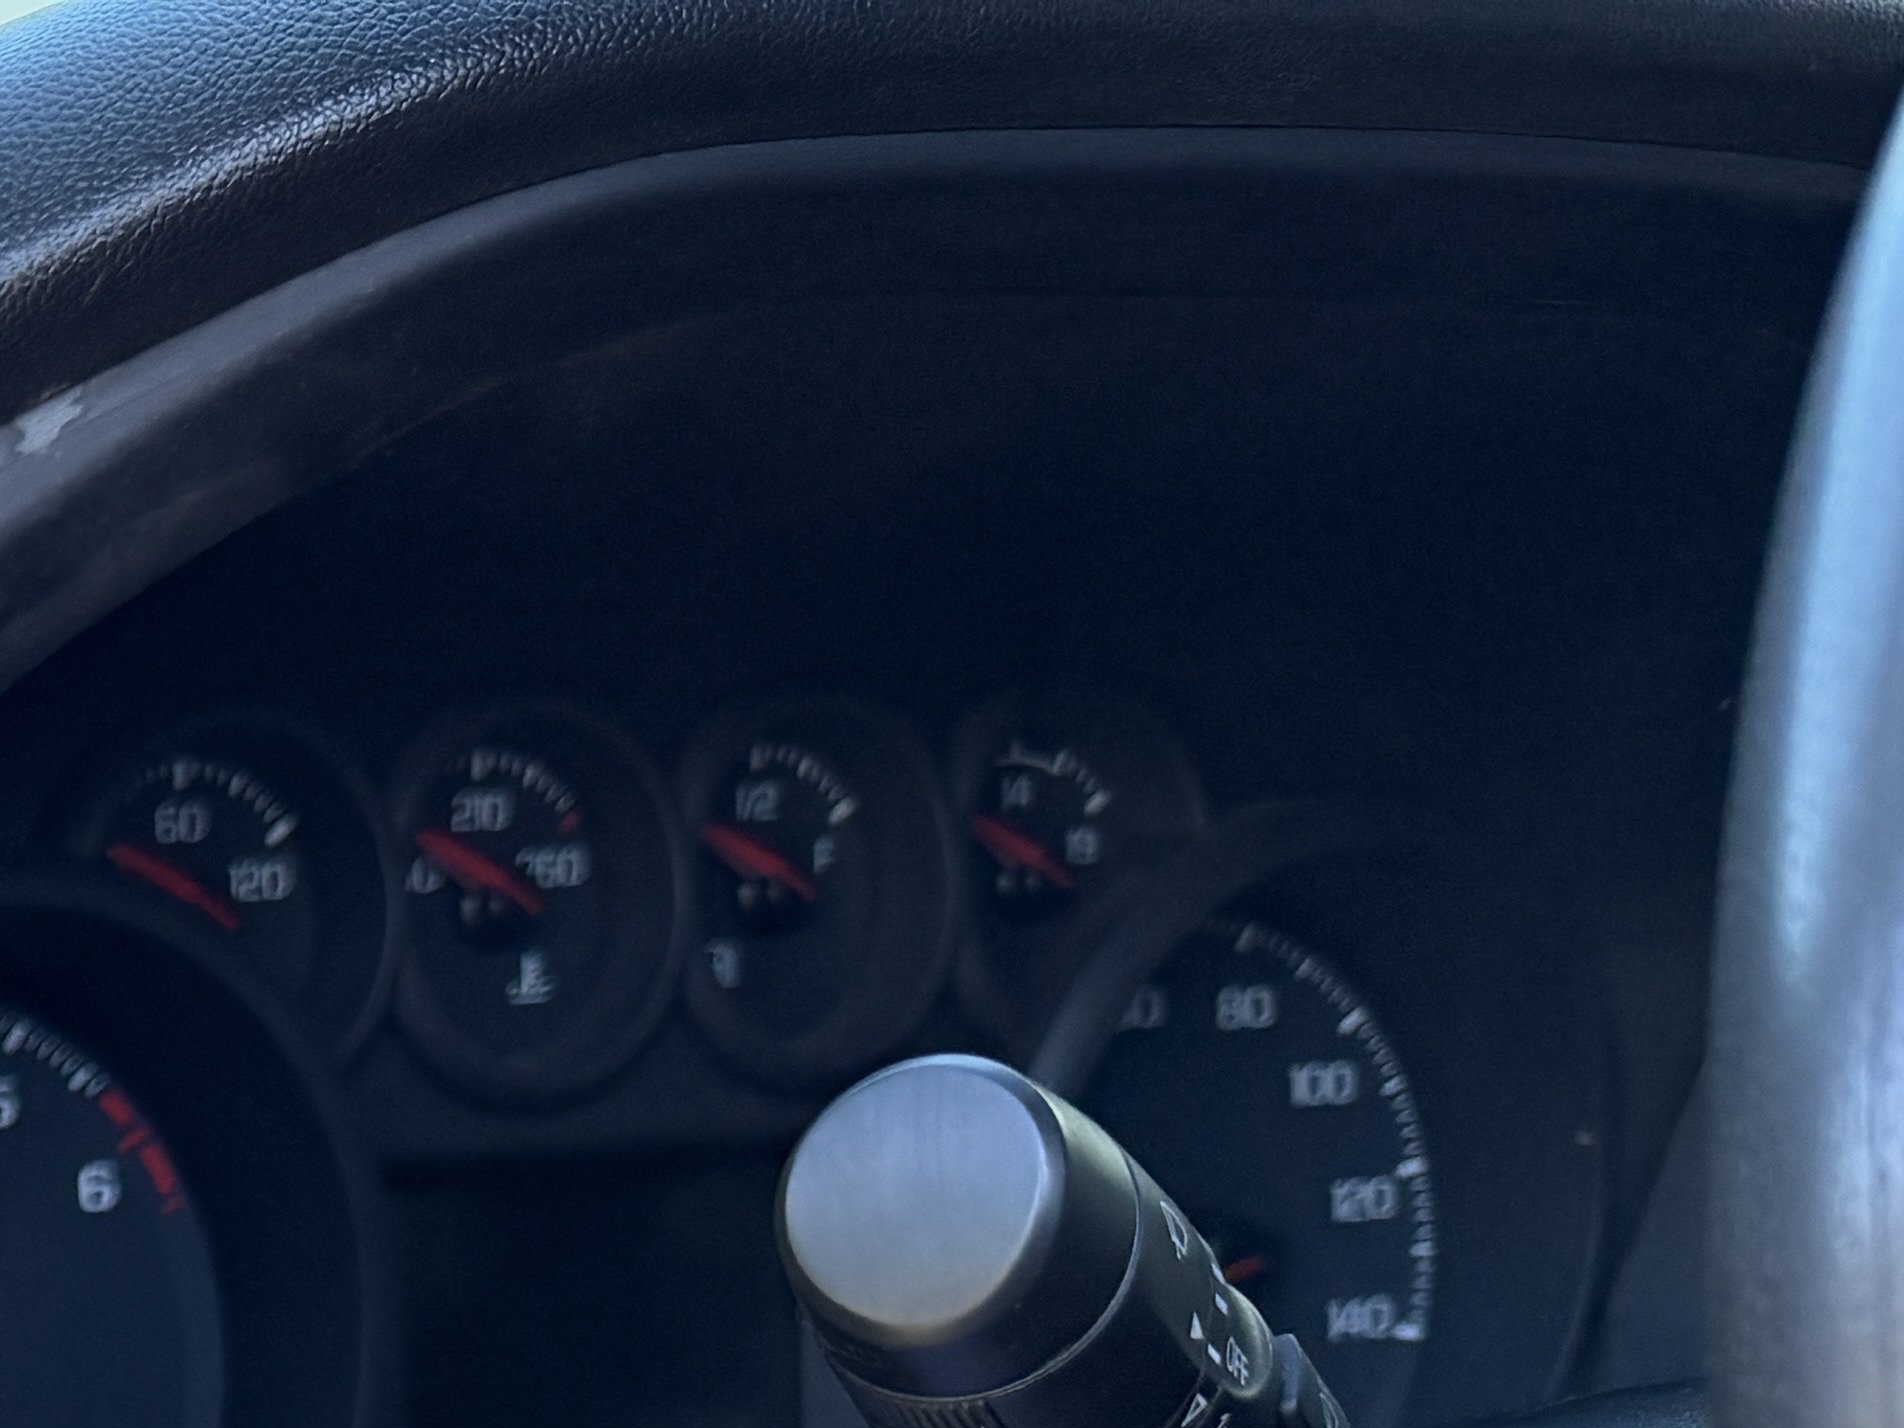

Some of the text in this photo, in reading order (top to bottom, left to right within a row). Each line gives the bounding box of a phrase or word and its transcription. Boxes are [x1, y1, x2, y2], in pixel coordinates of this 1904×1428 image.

[153, 800, 210, 845] 60
[229, 857, 296, 902] 120
[1216, 985, 1276, 1031] 80
[1289, 1060, 1358, 1107] 100
[77, 1160, 122, 1213] 6
